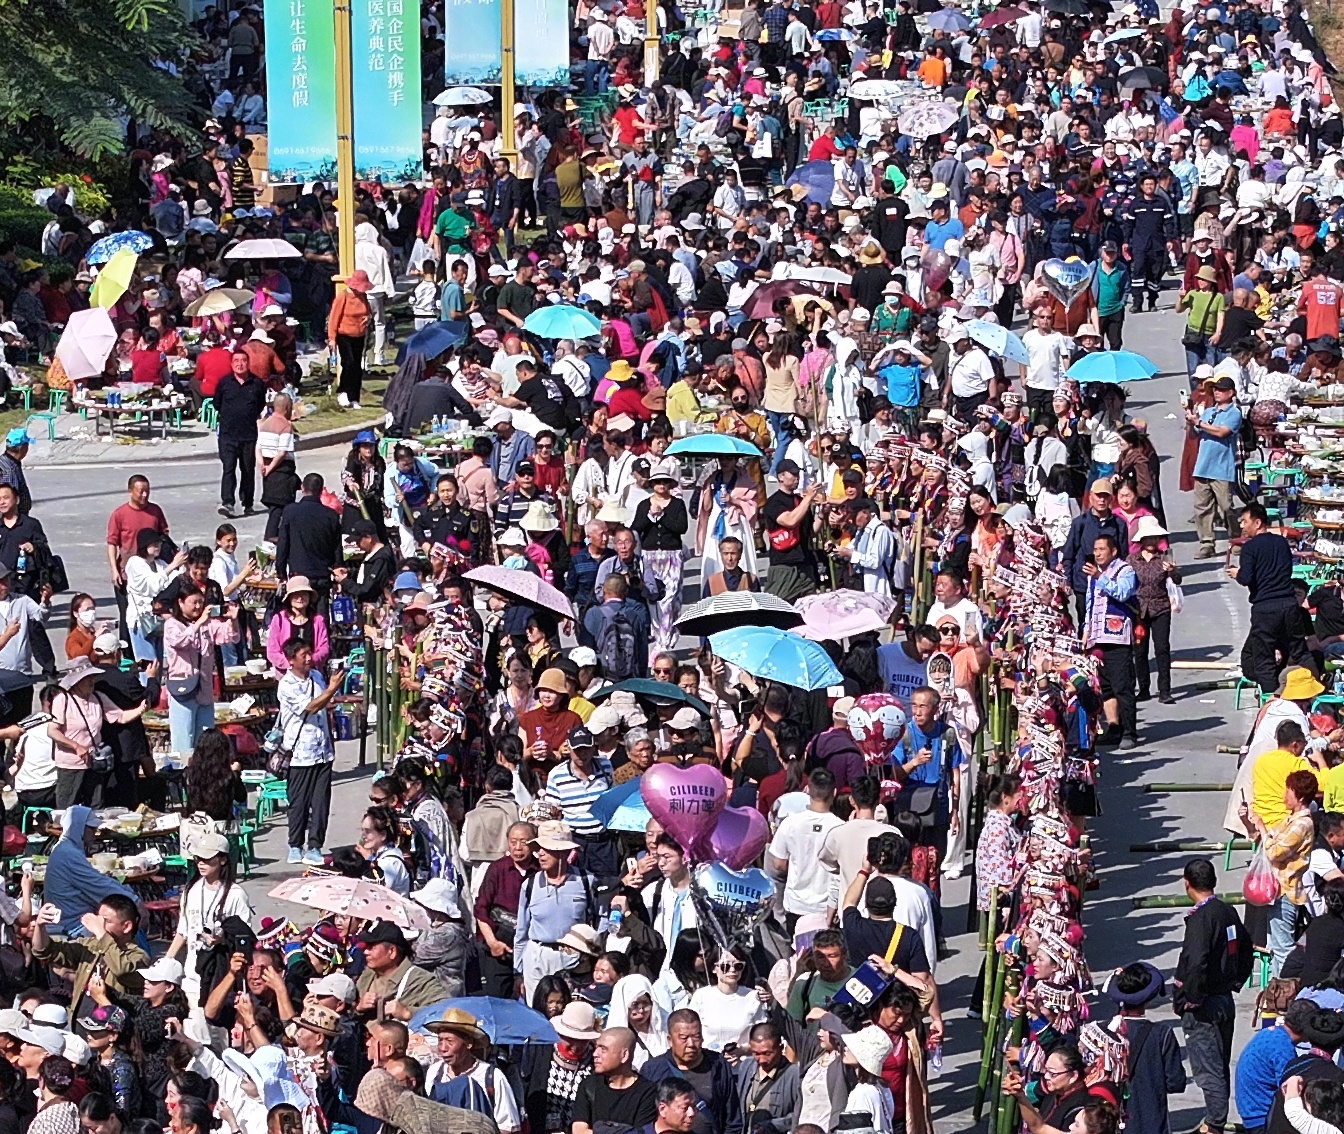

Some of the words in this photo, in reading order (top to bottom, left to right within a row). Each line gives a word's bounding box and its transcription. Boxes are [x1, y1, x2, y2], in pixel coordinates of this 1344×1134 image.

[368, 0, 385, 71] 医养典范
[290, 1, 309, 108] 让生命去度假
[387, 0, 404, 107] 国企民企携手
[889, 683, 916, 697] 刺力
[669, 785, 715, 797] CILIBEER
[669, 798, 715, 815] 刺力啤
[716, 882, 762, 900] CILIBEER
